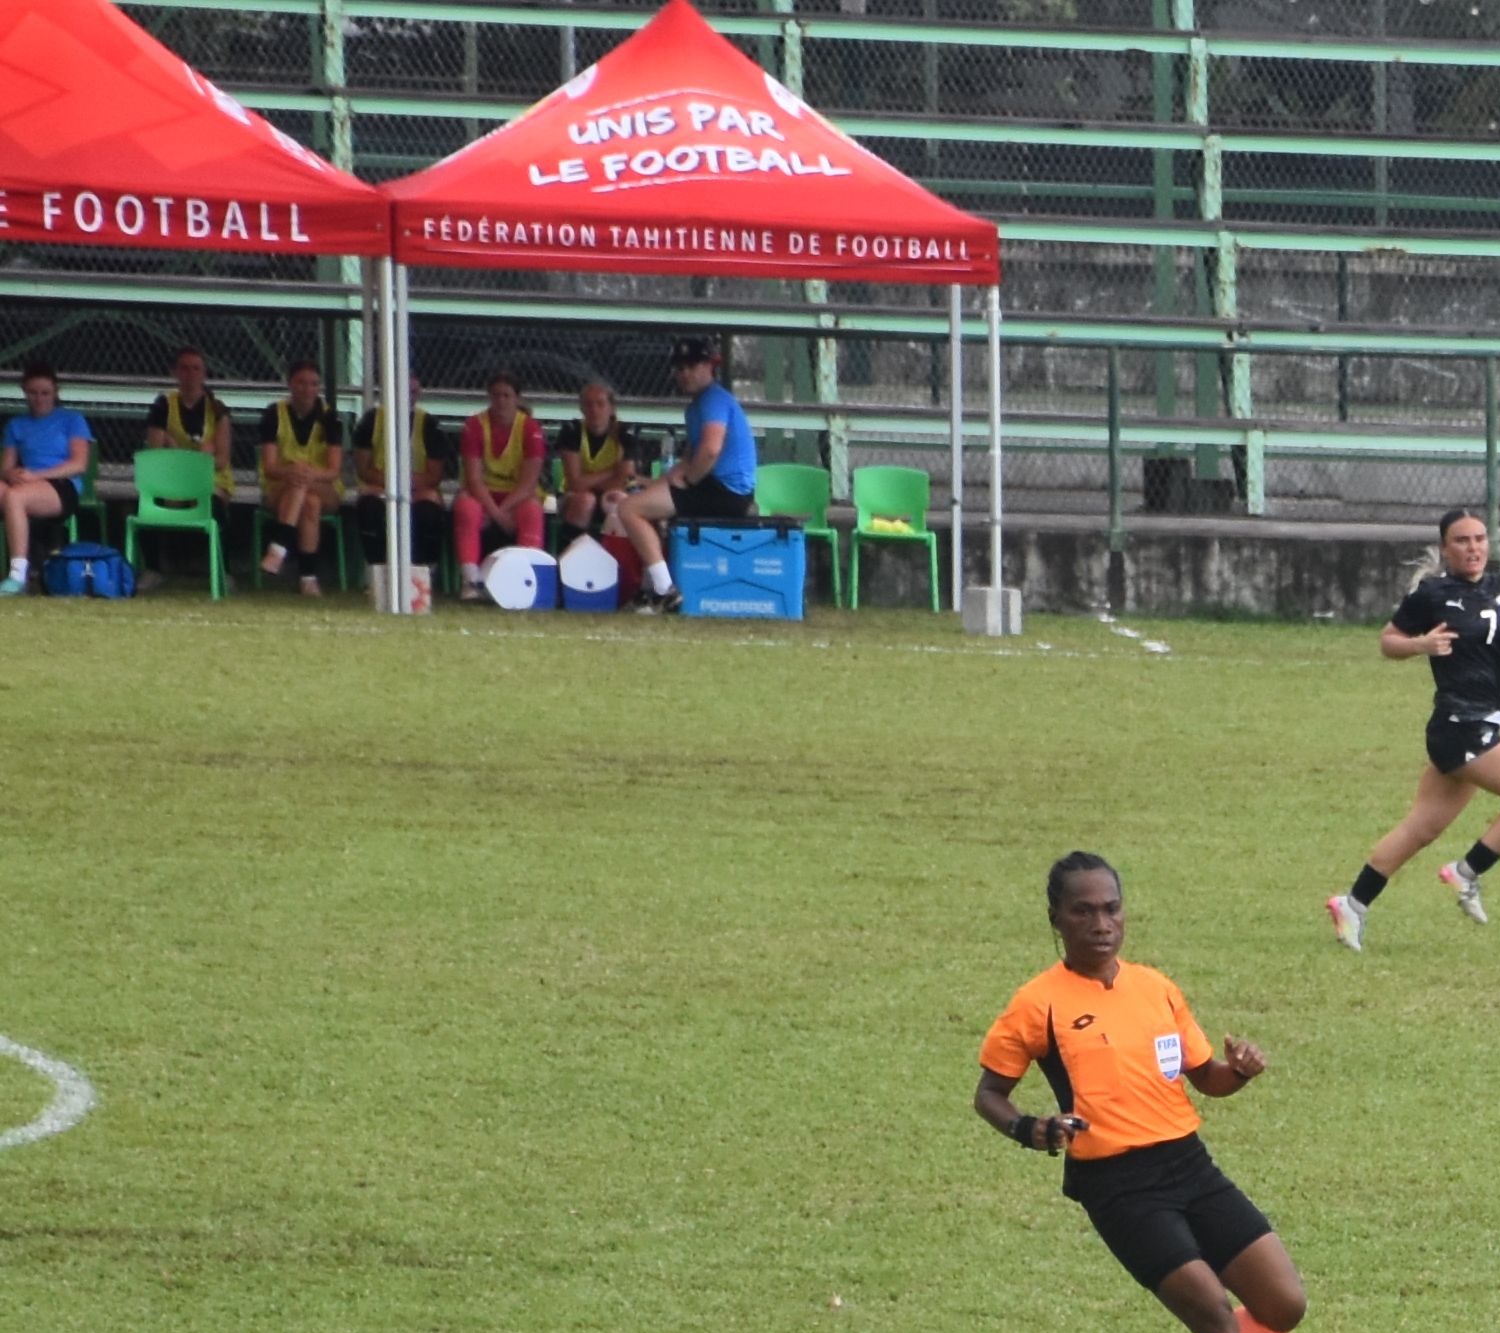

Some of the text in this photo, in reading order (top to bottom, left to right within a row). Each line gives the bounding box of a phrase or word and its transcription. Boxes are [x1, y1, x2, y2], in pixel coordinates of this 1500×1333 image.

[569, 101, 785, 145] UNIS PAR
[529, 143, 854, 187] LE FOOTBALL
[42, 191, 311, 243] FOOTBALL
[423, 215, 971, 262] FÉDÉRATION TAHITIENNE DE FOOTBALL
[1479, 608, 1498, 645] 7
